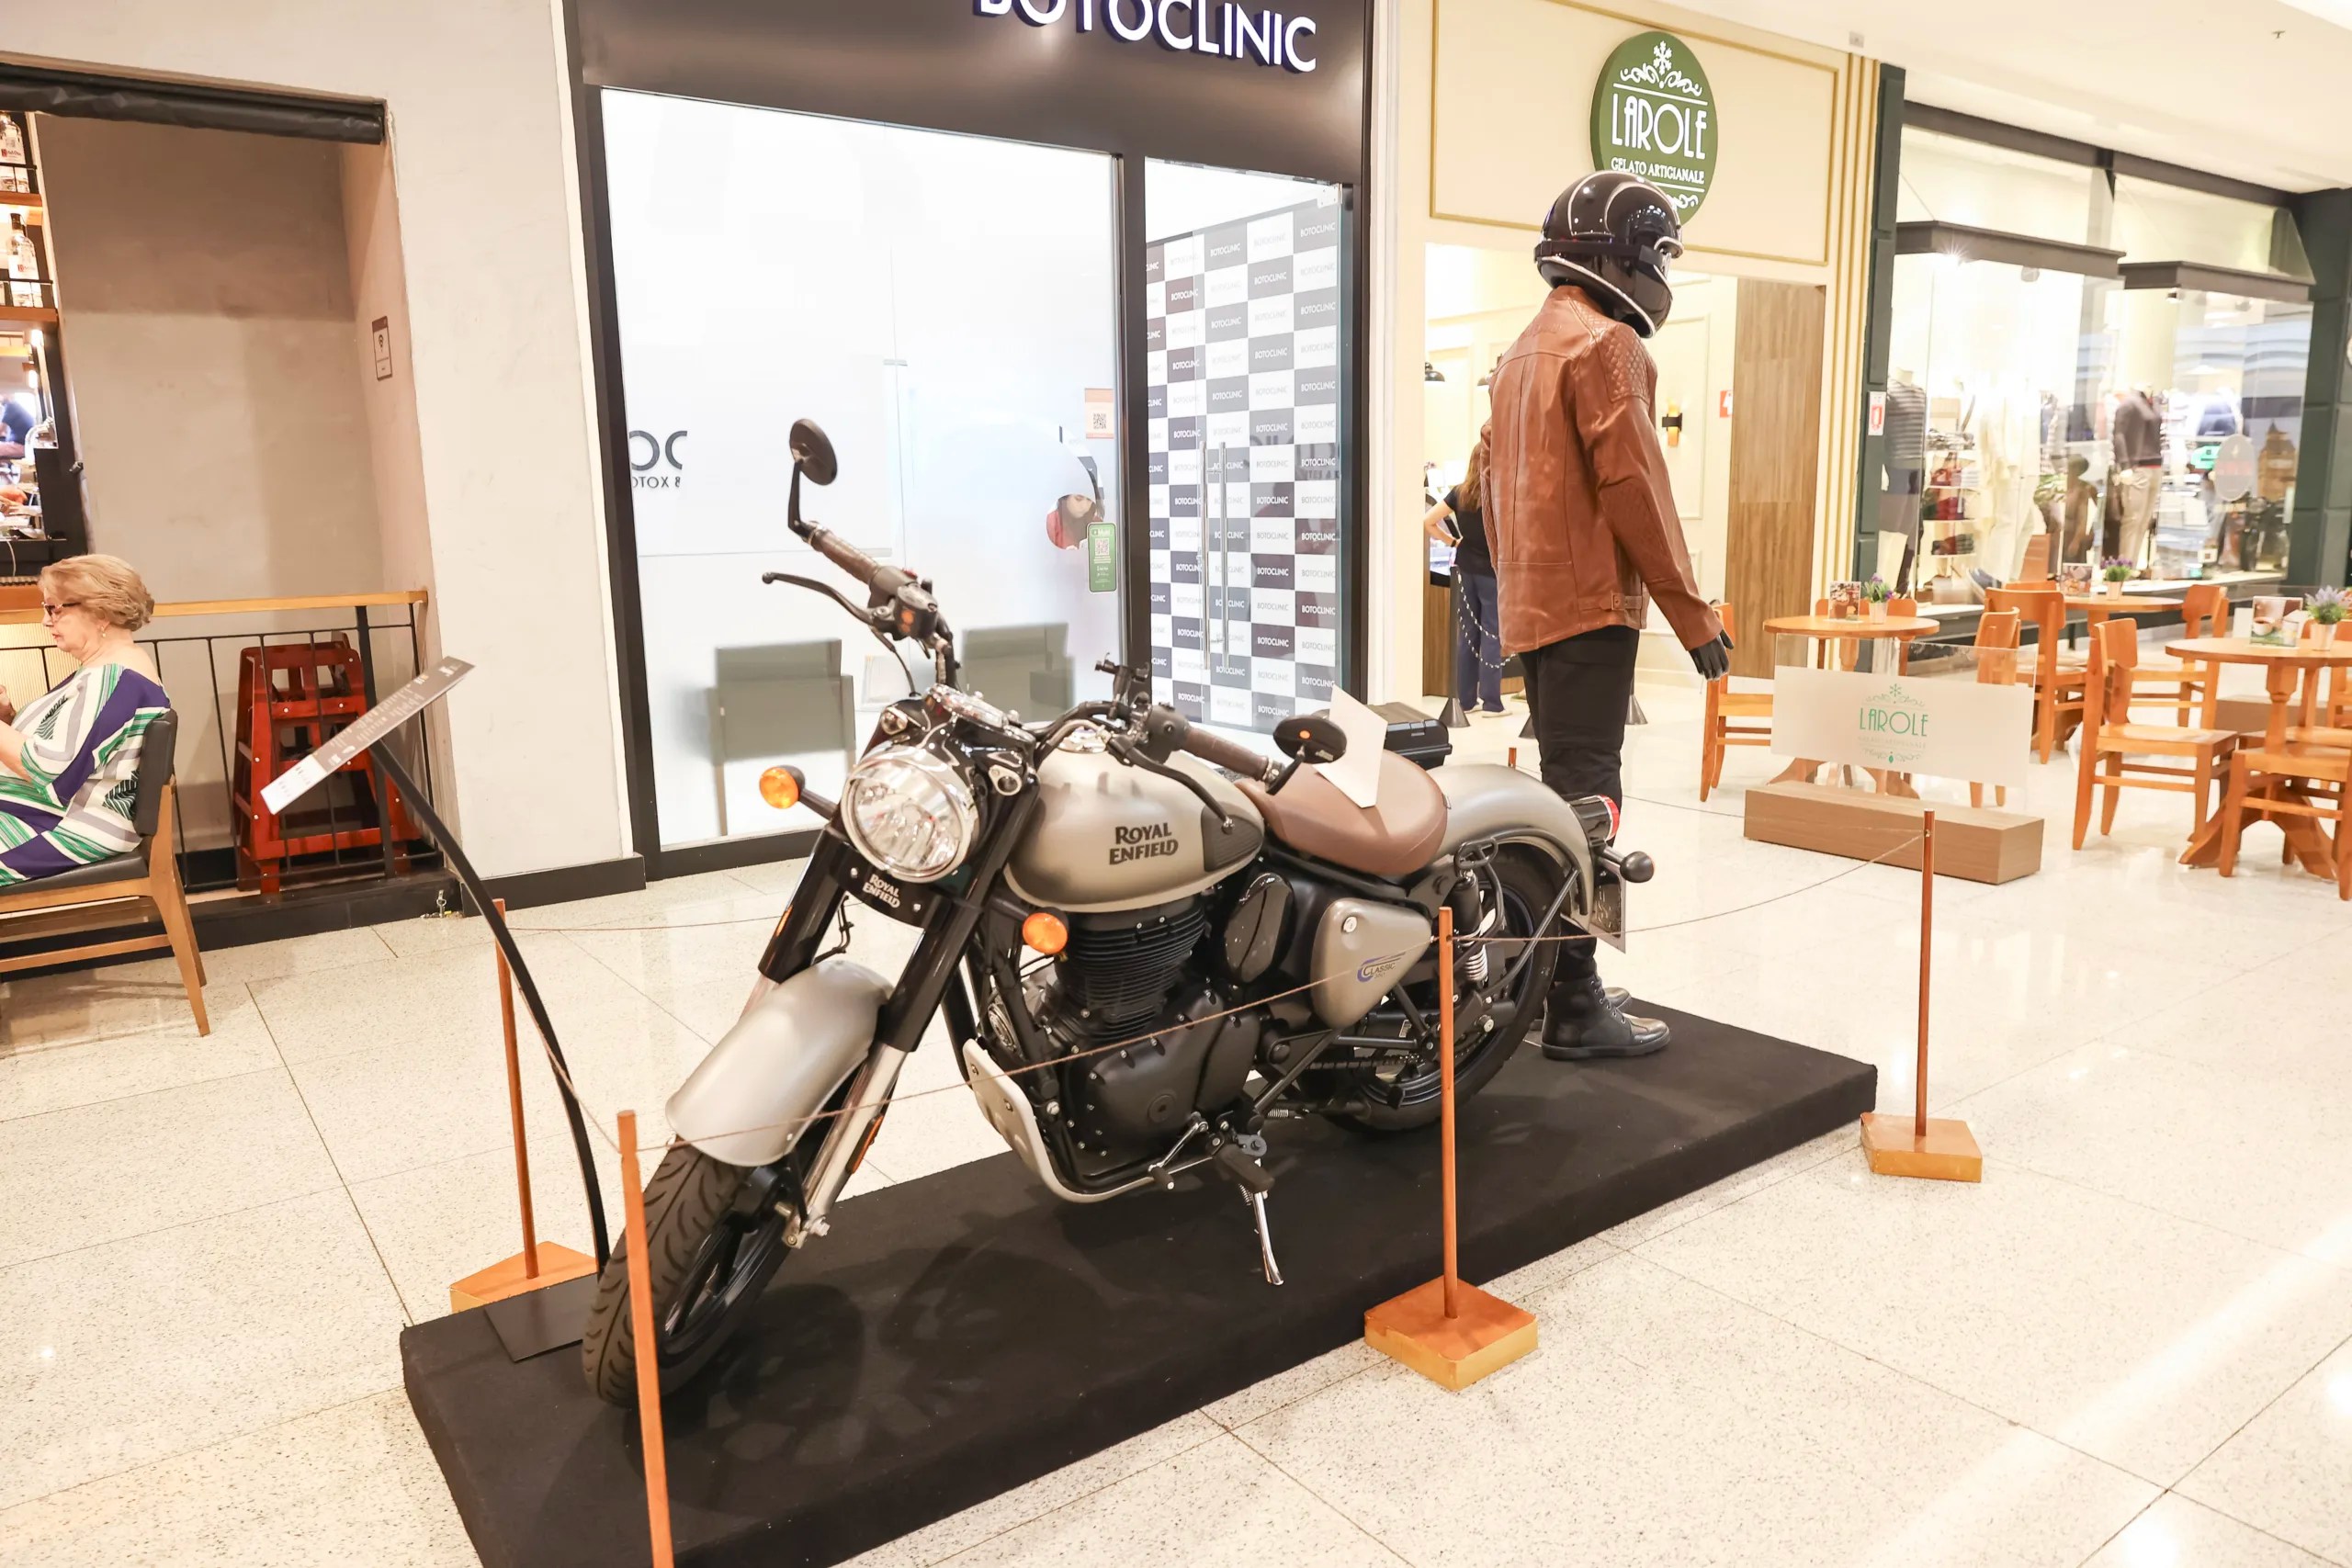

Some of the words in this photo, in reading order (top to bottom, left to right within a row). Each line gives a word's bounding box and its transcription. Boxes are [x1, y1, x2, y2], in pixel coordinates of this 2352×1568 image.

[976, 0, 1317, 73] OCLINIC
[1612, 93, 1707, 160] LAROLE
[1611, 156, 1647, 175] GELATO
[1647, 163, 1705, 185] ARTIGIANALE
[1300, 222, 1336, 238] BOTOCLINIC
[1210, 243, 1241, 257] BOTOCLINIC
[1254, 272, 1287, 286] BOTOCLINIC
[1301, 301, 1337, 315] BOTOCLINIC
[1211, 316, 1242, 329] BOTOCLINIC
[1254, 347, 1288, 360] BOTOCLINIC
[1301, 380, 1336, 392] BOTOCLINIC
[1212, 389, 1242, 400] BOTOCLINIC
[1256, 423, 1288, 434] BOTOCLINIC
[1301, 458, 1336, 468] BOTOCLINIC
[1256, 496, 1288, 504] BOTOCLINIC
[1302, 533, 1336, 541] BOTOCLINIC
[1258, 568, 1289, 576] BOTOCLINIC
[1302, 605, 1336, 615] BOTOCLINIC
[1258, 637, 1289, 647] BOTOCLINIC
[1859, 707, 1928, 737] LAROLE
[1115, 822, 1172, 845] ROYAL
[1109, 839, 1179, 865] ENFIELD
[869, 874, 899, 897] ROYAL
[862, 882, 900, 908] ENFIELD
